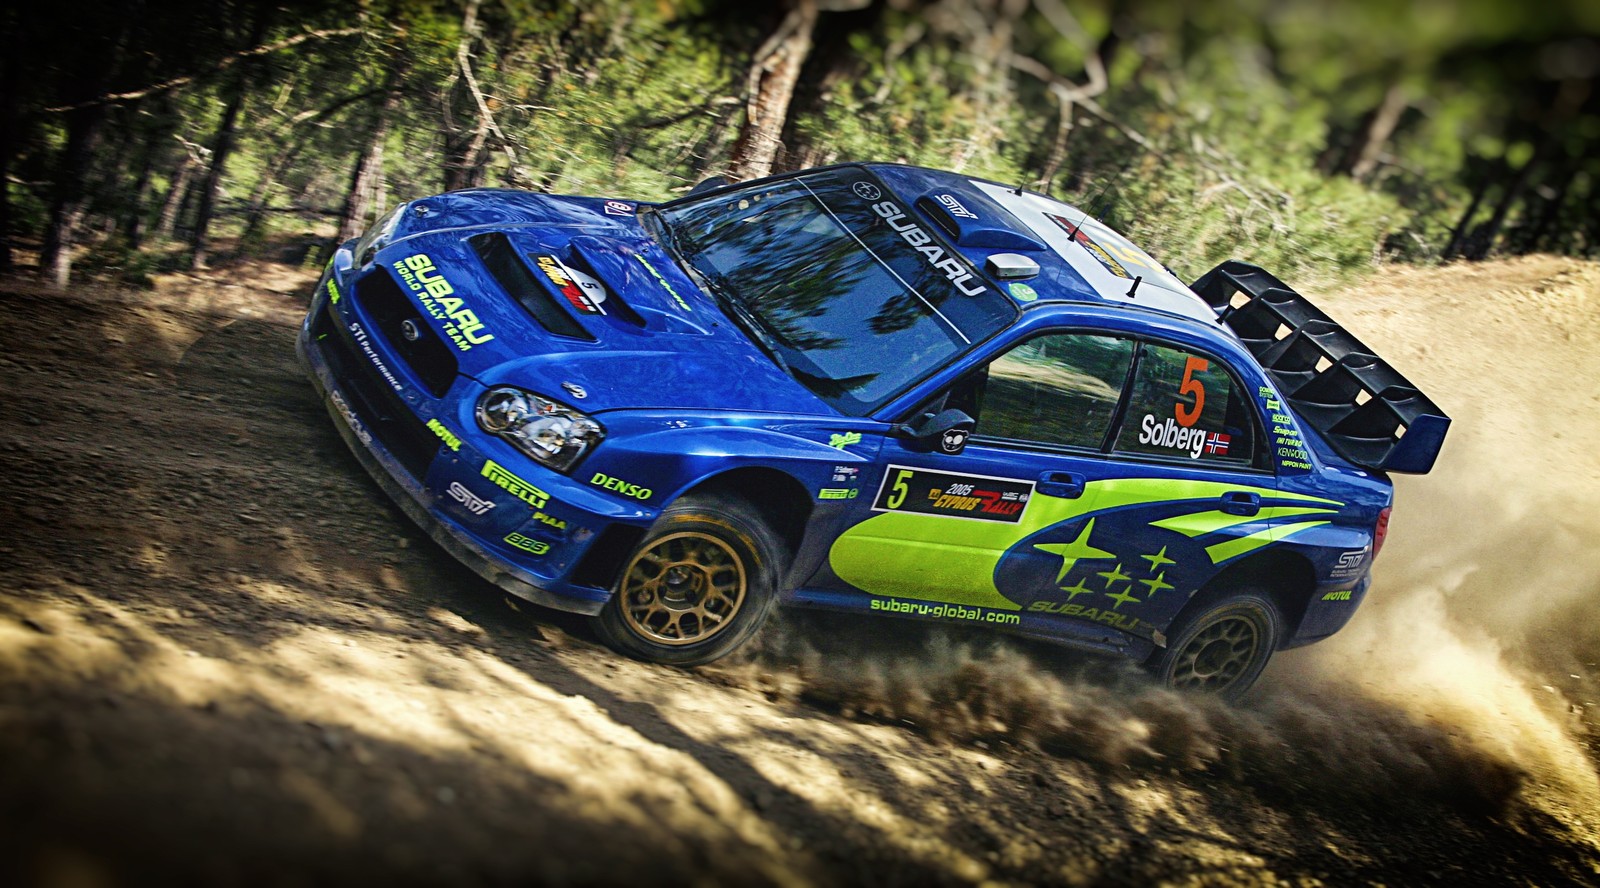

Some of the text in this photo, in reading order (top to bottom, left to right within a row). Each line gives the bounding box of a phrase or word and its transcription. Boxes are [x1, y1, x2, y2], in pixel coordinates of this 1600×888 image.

[871, 200, 988, 297] SUBARU
[393, 260, 472, 351] WORLD RALLY TEAM
[404, 253, 495, 344] SUBARU
[361, 340, 403, 391] Performance
[1175, 356, 1209, 428] 5
[426, 418, 462, 452] MOTUL
[1139, 414, 1207, 459] Solberg
[1277, 447, 1308, 460] KENWOOD
[1281, 460, 1300, 468] NIPPON
[480, 459, 551, 509] PIRELLI
[590, 472, 652, 499] DENSO
[887, 470, 914, 509] 5
[945, 483, 975, 496] 2005
[932, 494, 982, 511] CYPRUS
[973, 489, 1023, 515] RALLY
[532, 511, 567, 529] PIAA
[505, 532, 550, 554] BBS
[1321, 591, 1352, 600] MOTUL
[870, 598, 1020, 624] subaru-global.com
[1029, 600, 1139, 630] SUBARU
